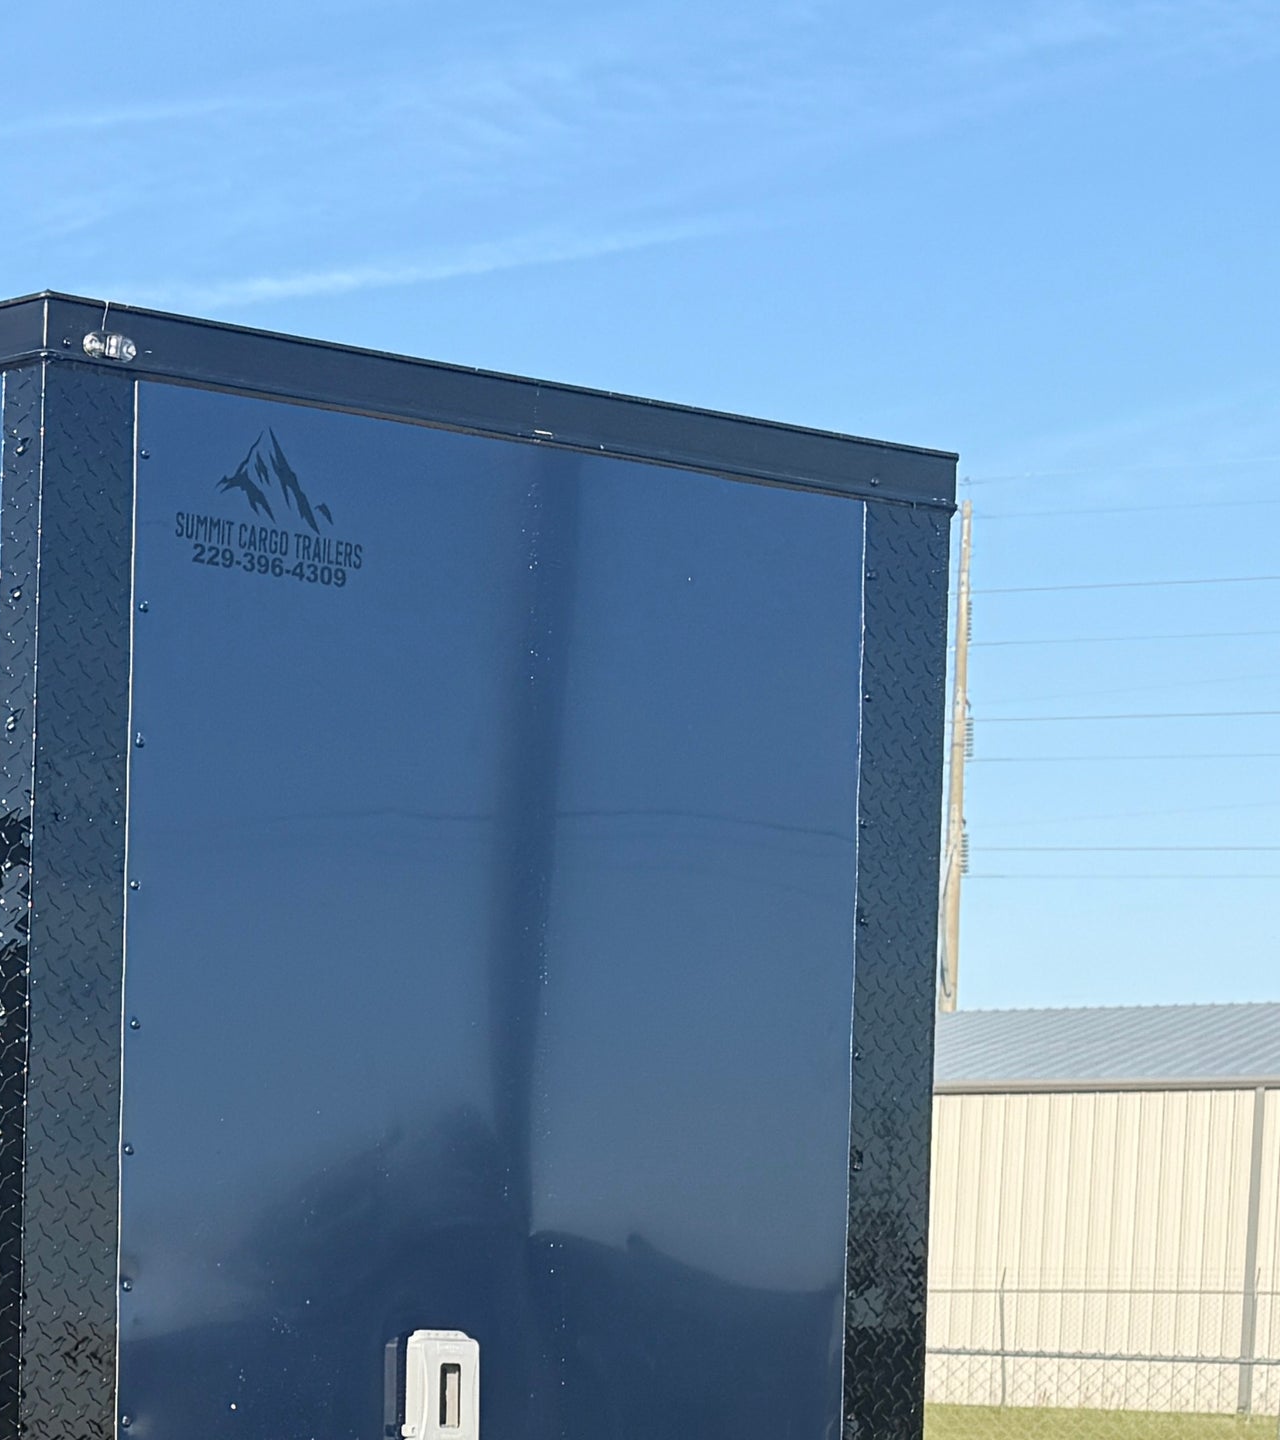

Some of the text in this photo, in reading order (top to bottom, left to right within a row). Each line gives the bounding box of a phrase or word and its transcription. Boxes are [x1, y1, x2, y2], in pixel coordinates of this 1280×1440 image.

[175, 511, 363, 569] SUMMIT CARGO TRAILERS
[192, 543, 346, 588] 229-396-4309
